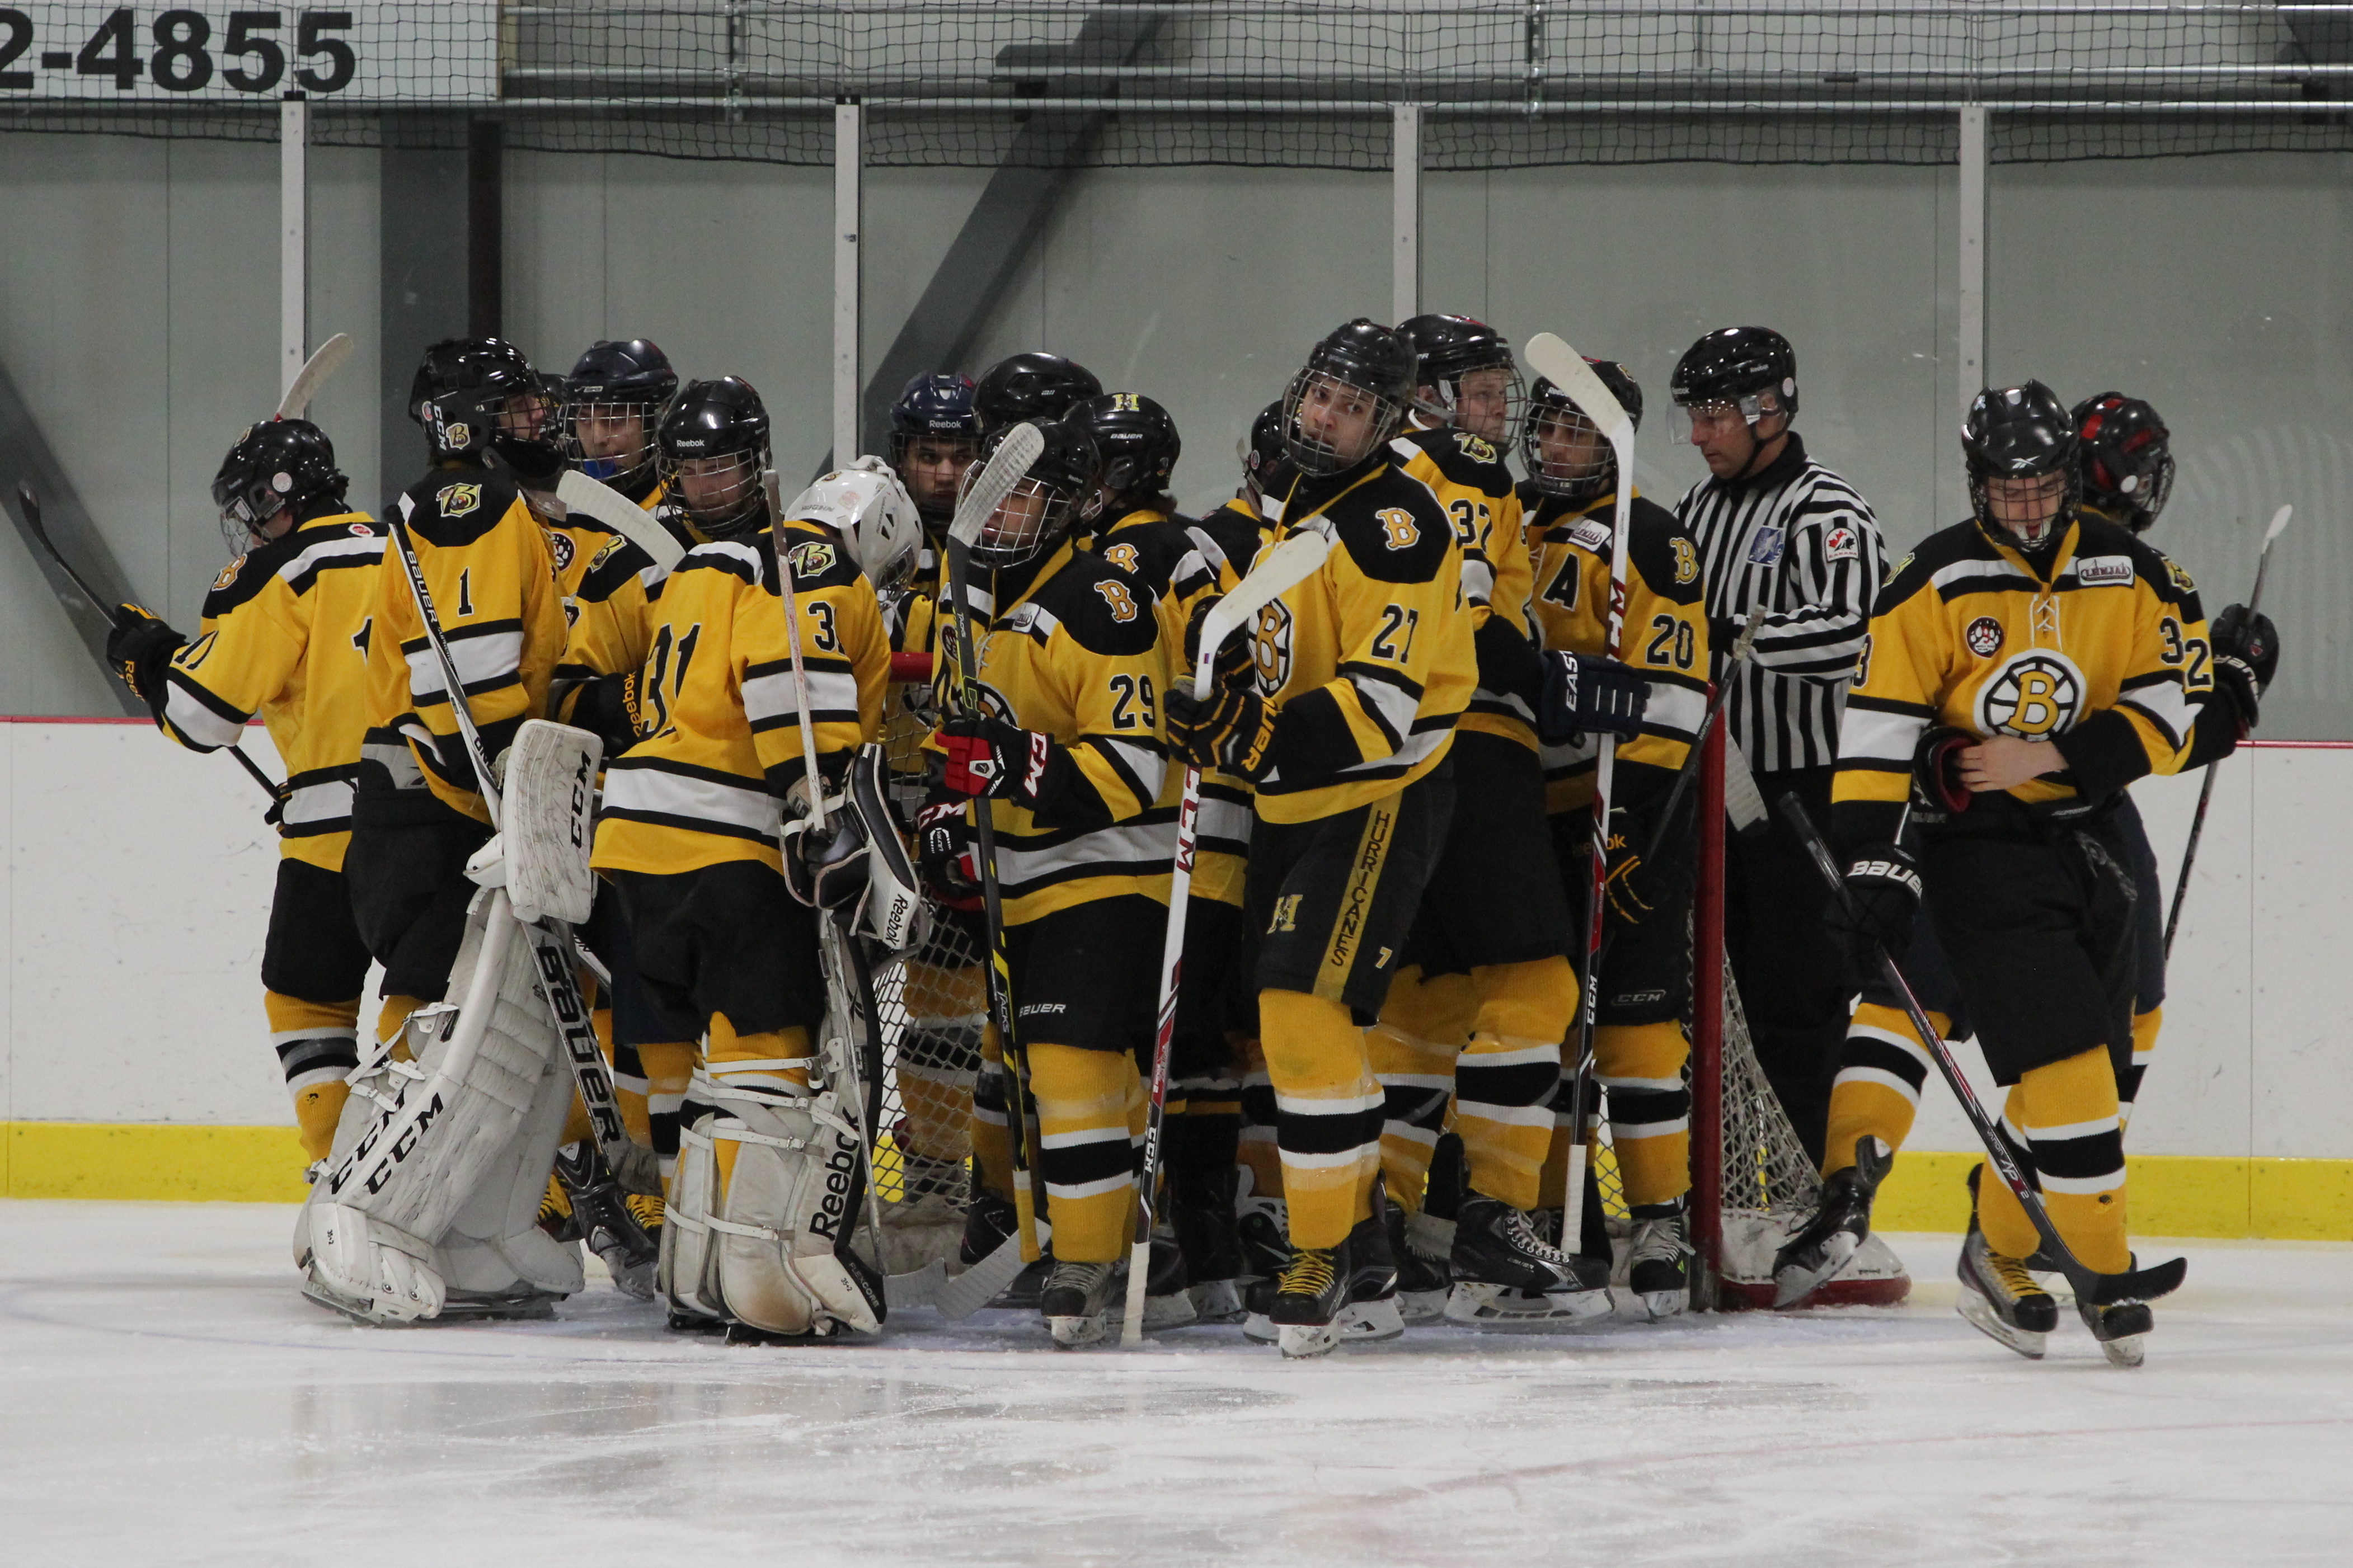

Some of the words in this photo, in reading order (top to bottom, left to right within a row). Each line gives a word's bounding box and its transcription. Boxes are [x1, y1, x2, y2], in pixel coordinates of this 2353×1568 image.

[434, 404, 447, 451] CCM
[677, 439, 705, 448] Reebok
[929, 420, 961, 429] Reebok
[1375, 507, 1421, 551] B
[406, 550, 438, 623] BAUER
[1541, 552, 1579, 611] A
[1669, 537, 1700, 583] B
[457, 566, 475, 618] 1
[1094, 579, 1138, 623] B
[806, 600, 847, 657] 3
[1370, 603, 1419, 665] 27
[1646, 613, 1695, 671] 20
[1108, 673, 1156, 731] 29
[1558, 650, 1579, 712] EAST
[2008, 670, 2059, 735] B
[1023, 731, 1048, 797] CM
[570, 750, 591, 849] CCM
[918, 801, 967, 832] CM
[936, 830, 945, 852] ULTRA
[1331, 809, 1391, 967] HURRICANES
[1847, 860, 1923, 900] BAUE
[884, 893, 905, 950] Reebok
[1375, 946, 1393, 969] 7
[1586, 974, 1599, 1025] CCM
[536, 945, 621, 1146] BAUER
[363, 1091, 444, 1195] CCM
[1144, 1126, 1158, 1174] CCM
[848, 1261, 880, 1308] FLEXCORE
